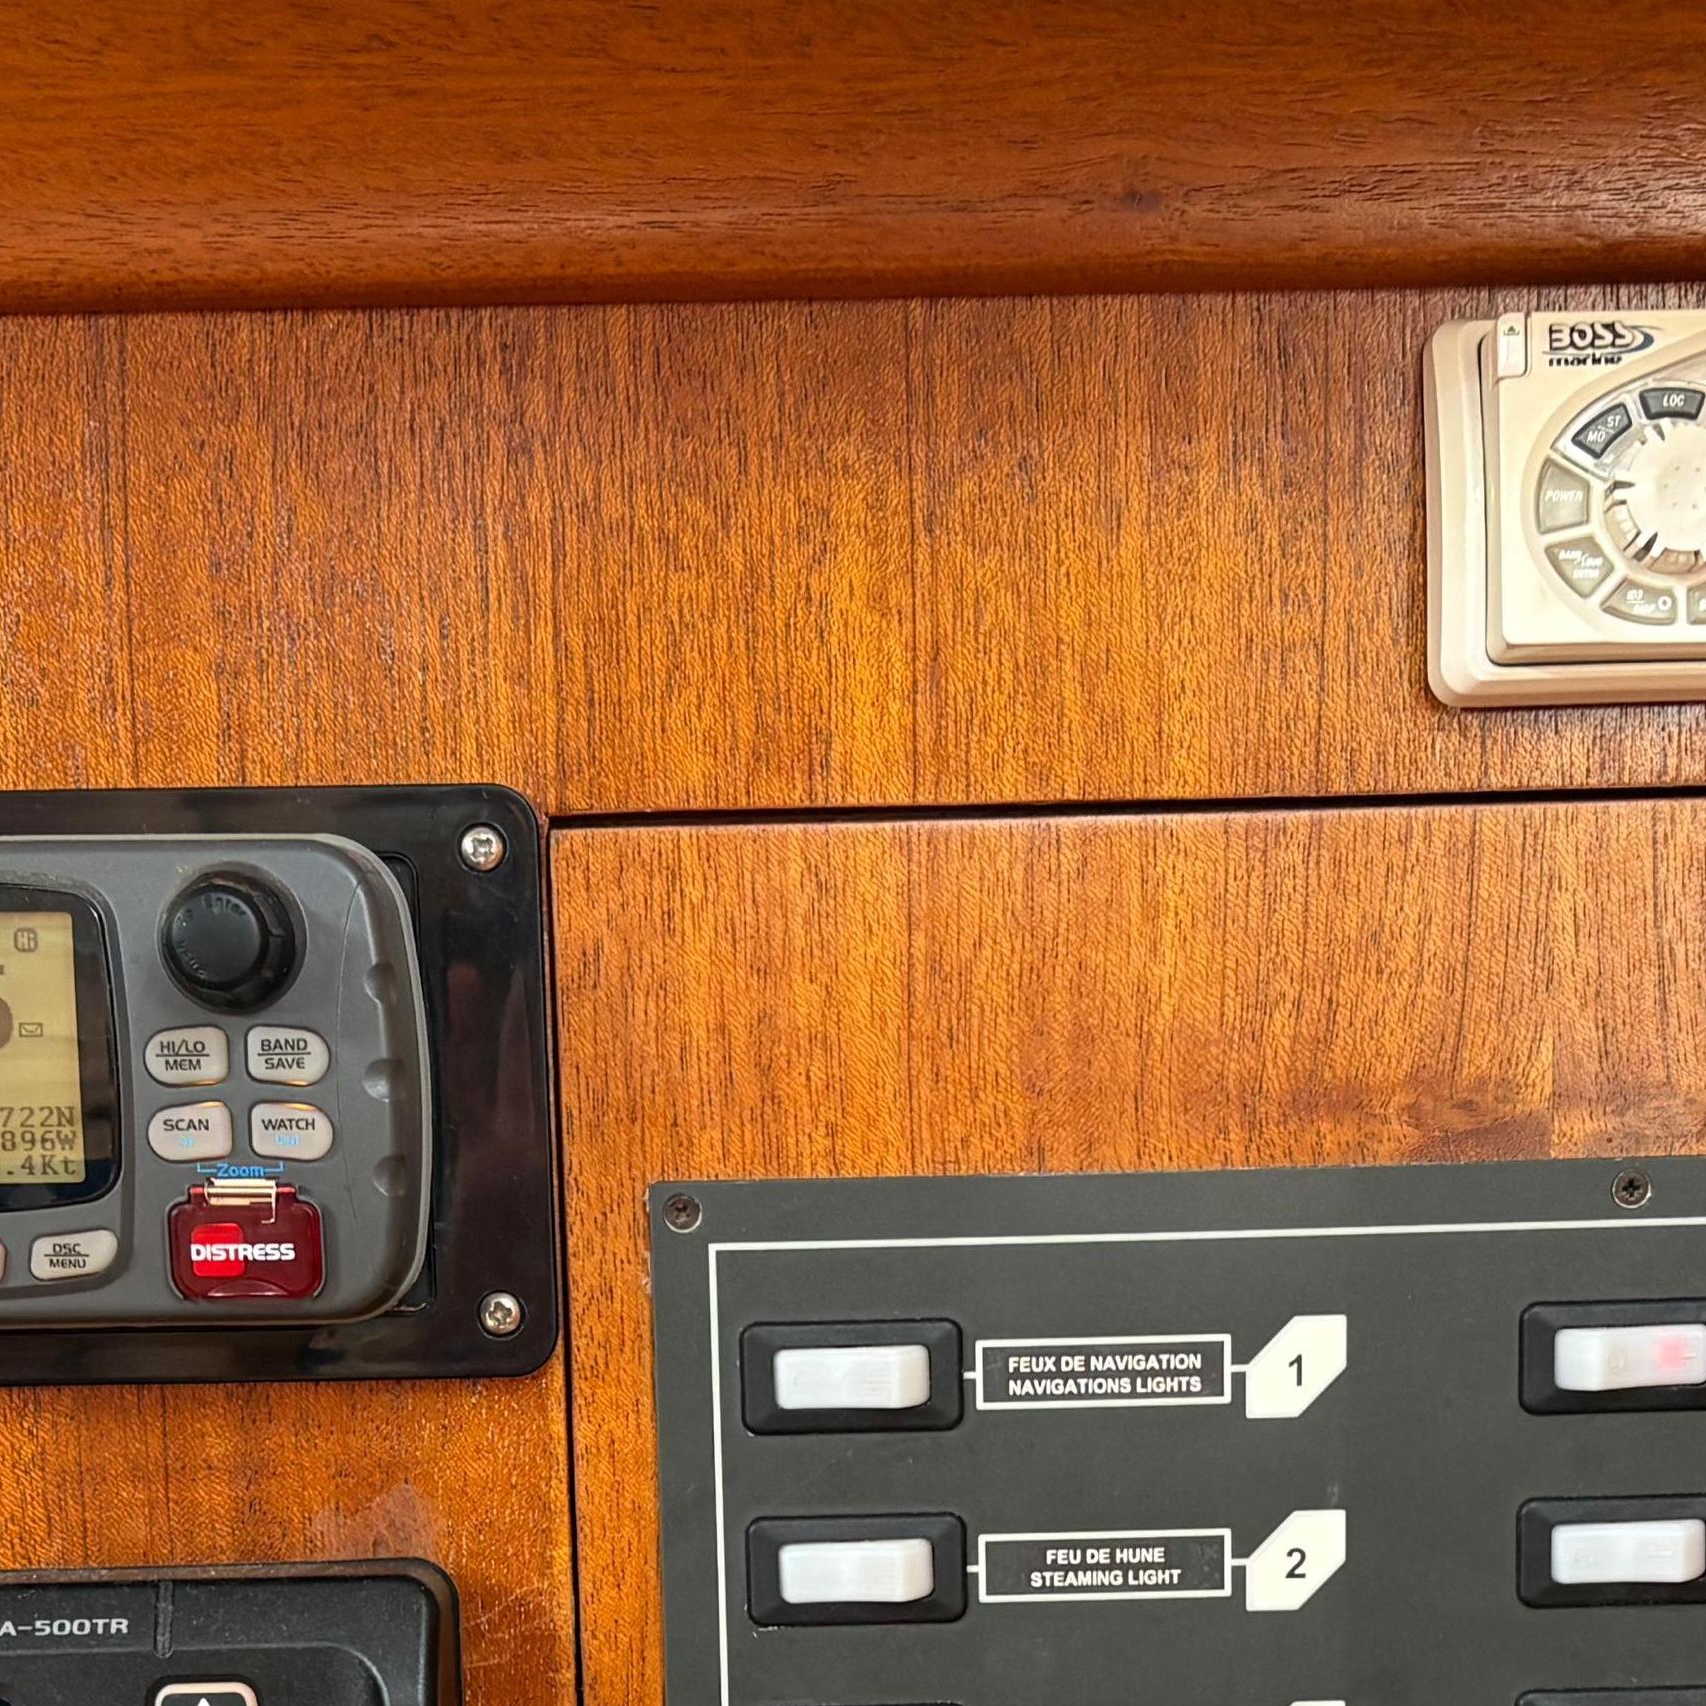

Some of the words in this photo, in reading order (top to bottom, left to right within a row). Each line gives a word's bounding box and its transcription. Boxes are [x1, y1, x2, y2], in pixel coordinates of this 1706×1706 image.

[160, 1039, 205, 1055] HI/LO
[261, 1039, 308, 1052] BAND
[165, 1058, 201, 1071] MEM
[265, 1057, 305, 1070] SAVE
[163, 1119, 209, 1131] SCAN
[262, 1118, 315, 1130] WATCH
[217, 1164, 264, 1177] Zoom
[52, 1244, 81, 1255] DSC
[190, 1244, 295, 1261] DISTRESS
[49, 1258, 86, 1269] MENU
[1008, 1355, 1055, 1374] FEUX
[1059, 1355, 1086, 1373] DE
[1090, 1352, 1202, 1372] NAVIGATION
[1009, 1376, 1131, 1396] NAVIGATIONS
[1136, 1374, 1202, 1393] LIGHTS
[1283, 1548, 1307, 1579] 2
[1029, 1569, 1122, 1588] STEAMING
[1128, 1568, 1181, 1587] LIGHT
